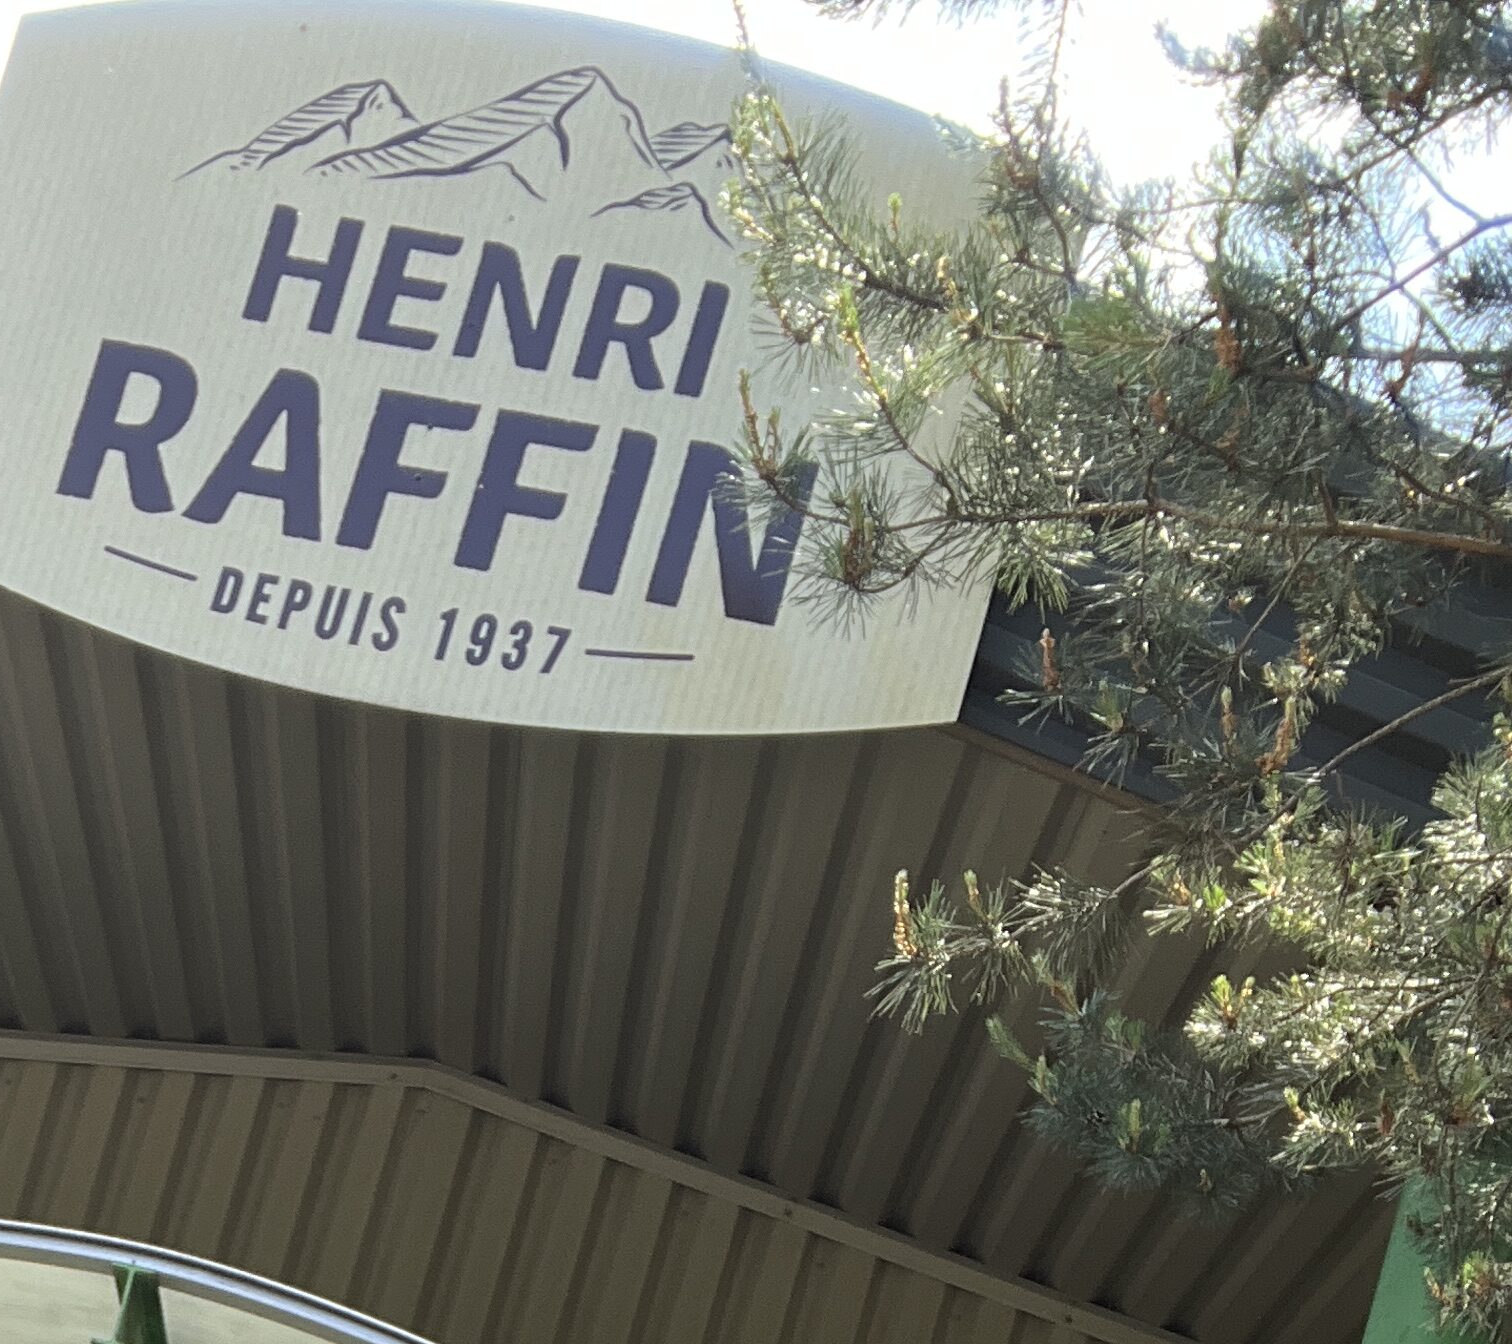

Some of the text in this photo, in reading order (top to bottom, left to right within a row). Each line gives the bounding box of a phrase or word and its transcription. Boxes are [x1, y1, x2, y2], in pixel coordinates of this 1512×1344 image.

[241, 203, 731, 399] HENRI
[55, 339, 820, 627] RAFFIN
[210, 566, 570, 675] DEPUIS 1937
